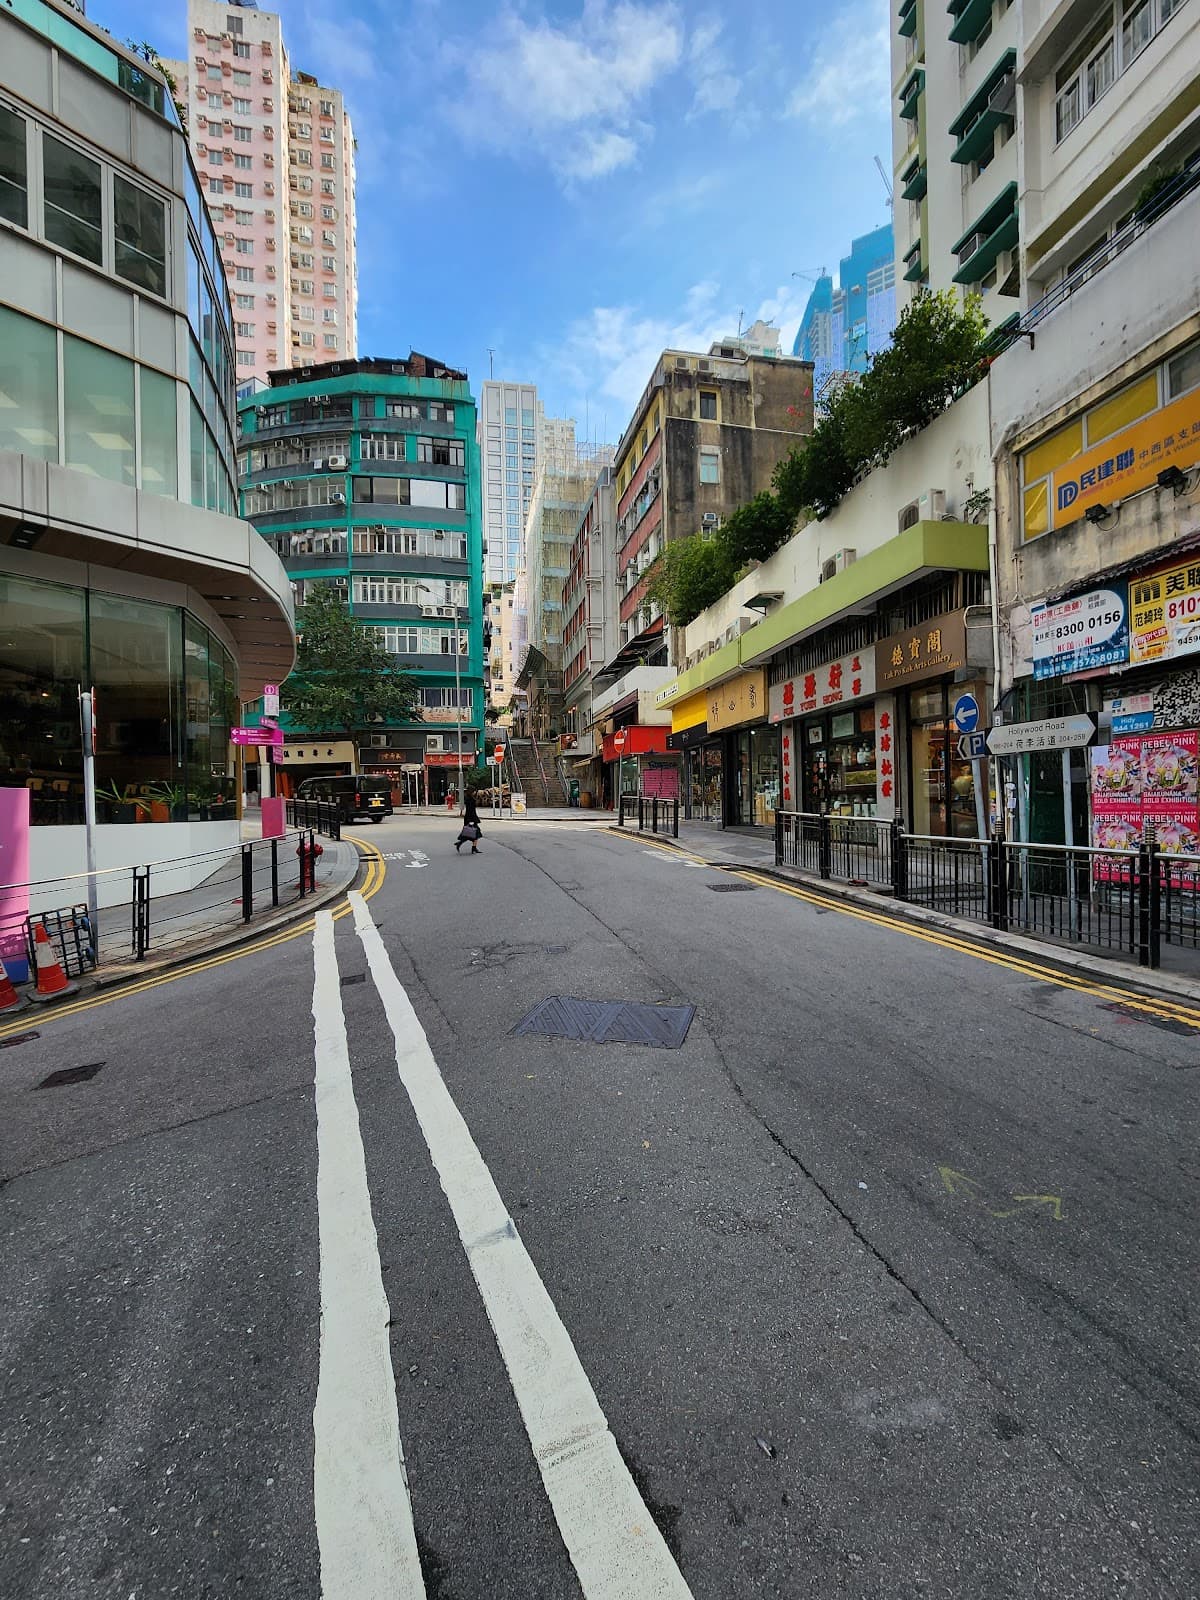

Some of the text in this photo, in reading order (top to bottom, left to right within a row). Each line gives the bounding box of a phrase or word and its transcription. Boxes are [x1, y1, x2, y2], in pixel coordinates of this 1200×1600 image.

[1080, 447, 1135, 491] 民建聯
[1056, 620, 1084, 639] 8300
[1088, 610, 1121, 629] 0156
[1008, 722, 1065, 736] Hollywood Road
[973, 738, 982, 754] P
[1016, 735, 1057, 749] 荷李活道
[1120, 742, 1140, 750] PINK
[1142, 740, 1170, 749] REBEL
[1172, 737, 1196, 746] PINK
[1094, 814, 1141, 822] REBEL PINK
[1143, 814, 1197, 823] REBEL PINK
